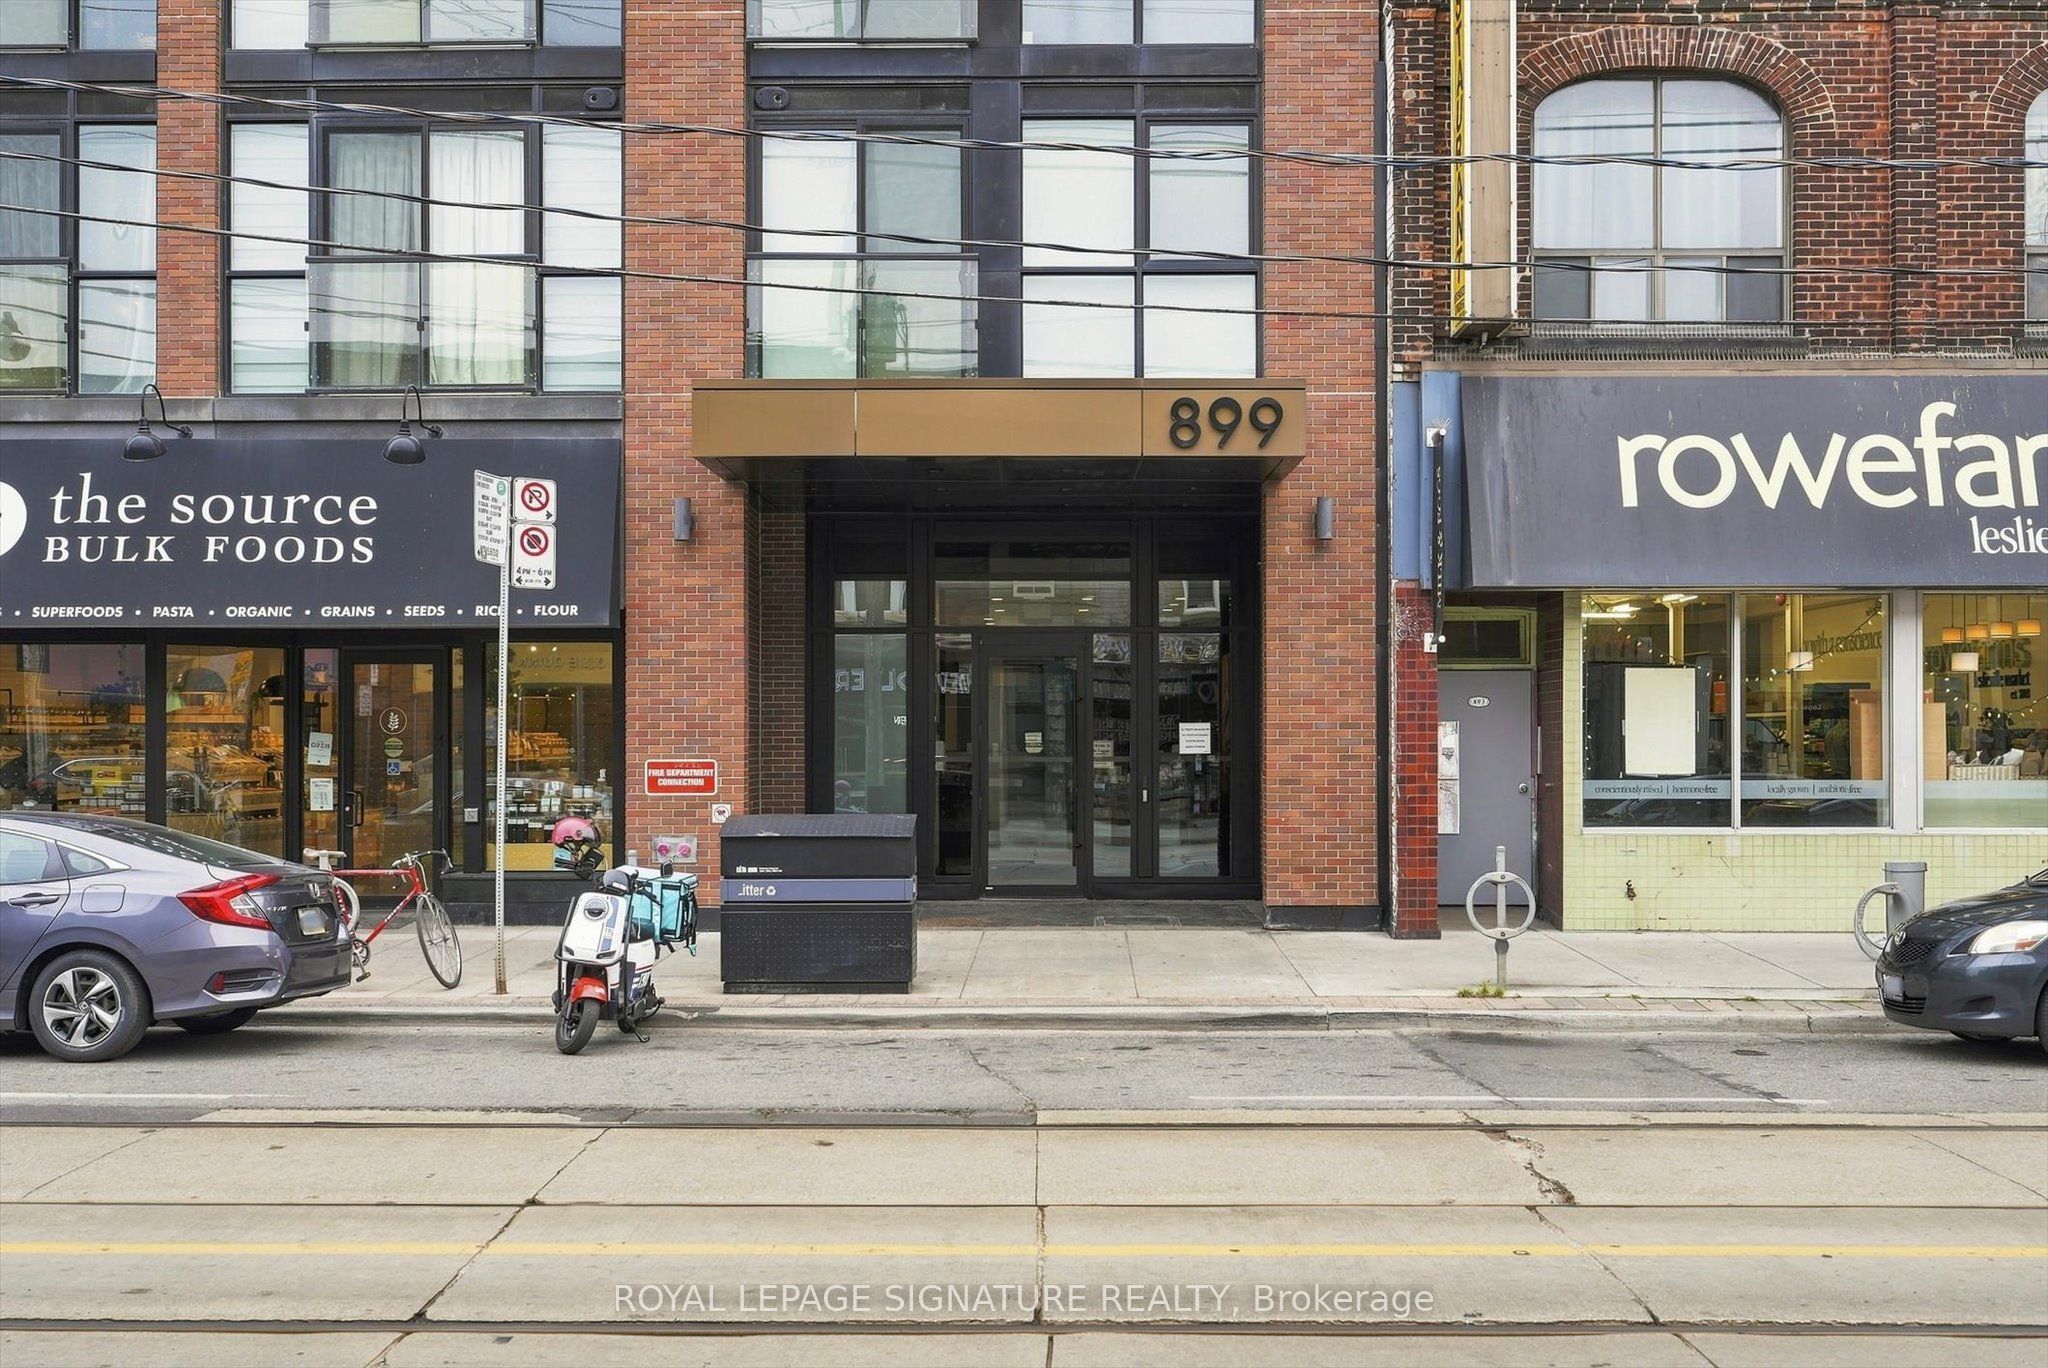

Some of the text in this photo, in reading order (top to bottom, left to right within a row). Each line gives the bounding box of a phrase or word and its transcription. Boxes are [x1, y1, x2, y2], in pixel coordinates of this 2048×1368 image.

[1170, 397, 1283, 450] 899
[50, 472, 377, 526] the source
[43, 536, 373, 564] BULK FOODS
[32, 605, 579, 618] SUPERFOODS PASTA ORGANIC GRAINS SEEDS RIC FLOUR
[649, 768, 714, 777] FIRE DEPARTMENT
[657, 777, 705, 786] CONNECTION
